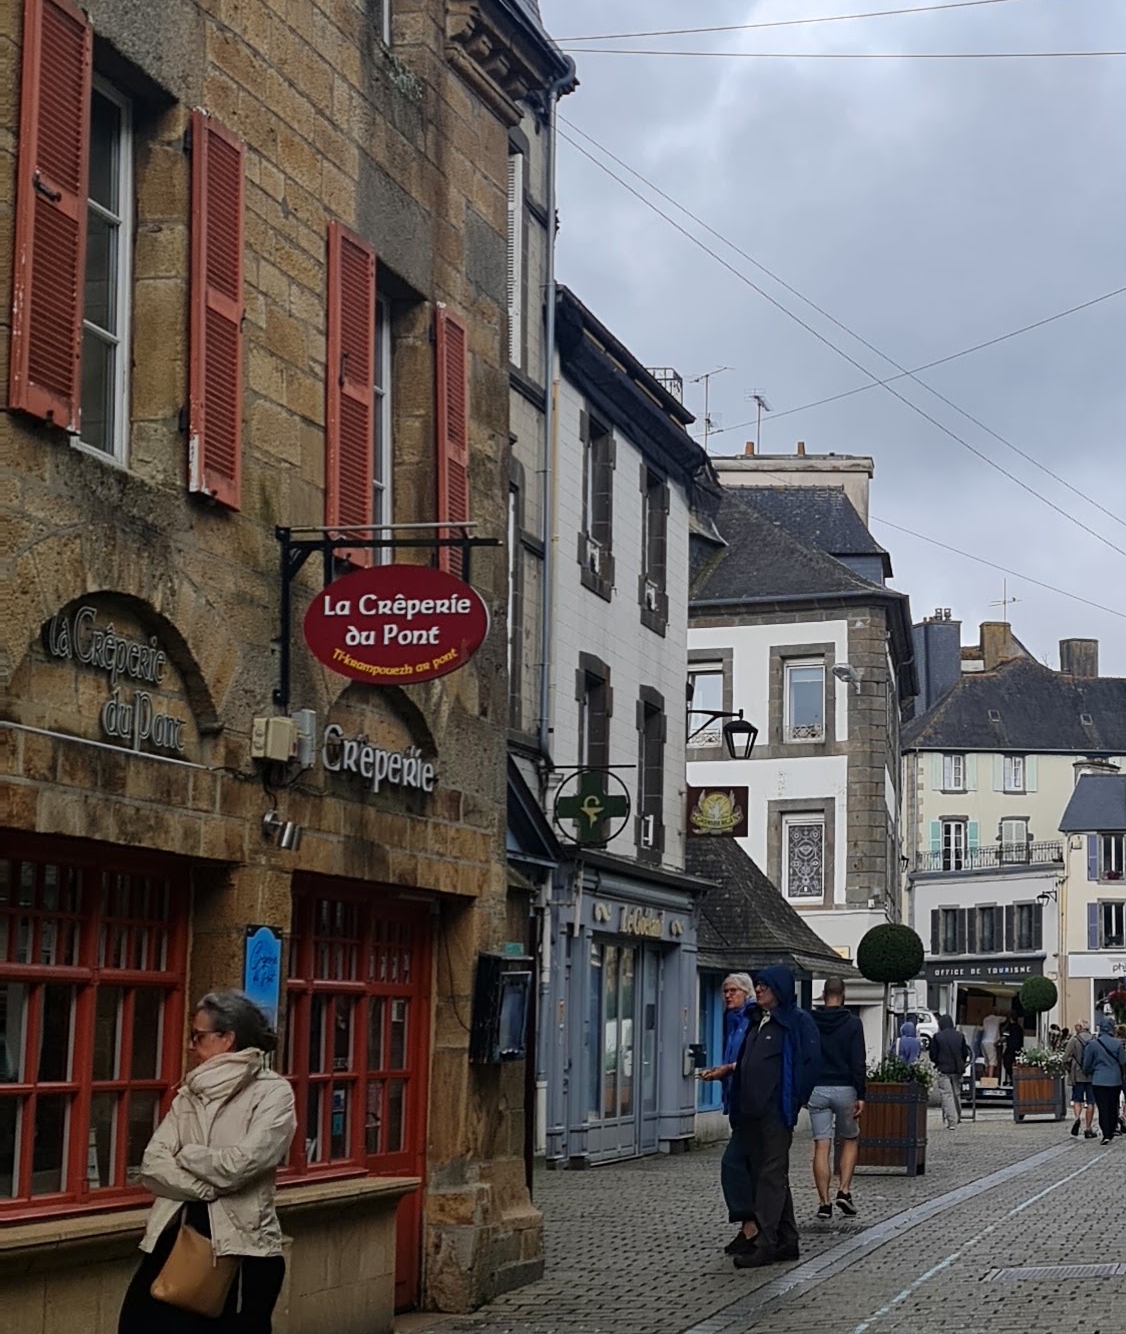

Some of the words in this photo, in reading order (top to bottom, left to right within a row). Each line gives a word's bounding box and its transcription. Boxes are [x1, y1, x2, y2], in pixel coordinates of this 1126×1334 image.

[324, 595, 350, 616] La
[358, 593, 471, 620] Crêperie
[345, 626, 376, 646] du
[383, 624, 440, 646] Pont
[432, 647, 458, 670] pont
[102, 686, 132, 739] du
[134, 689, 188, 751] Pont
